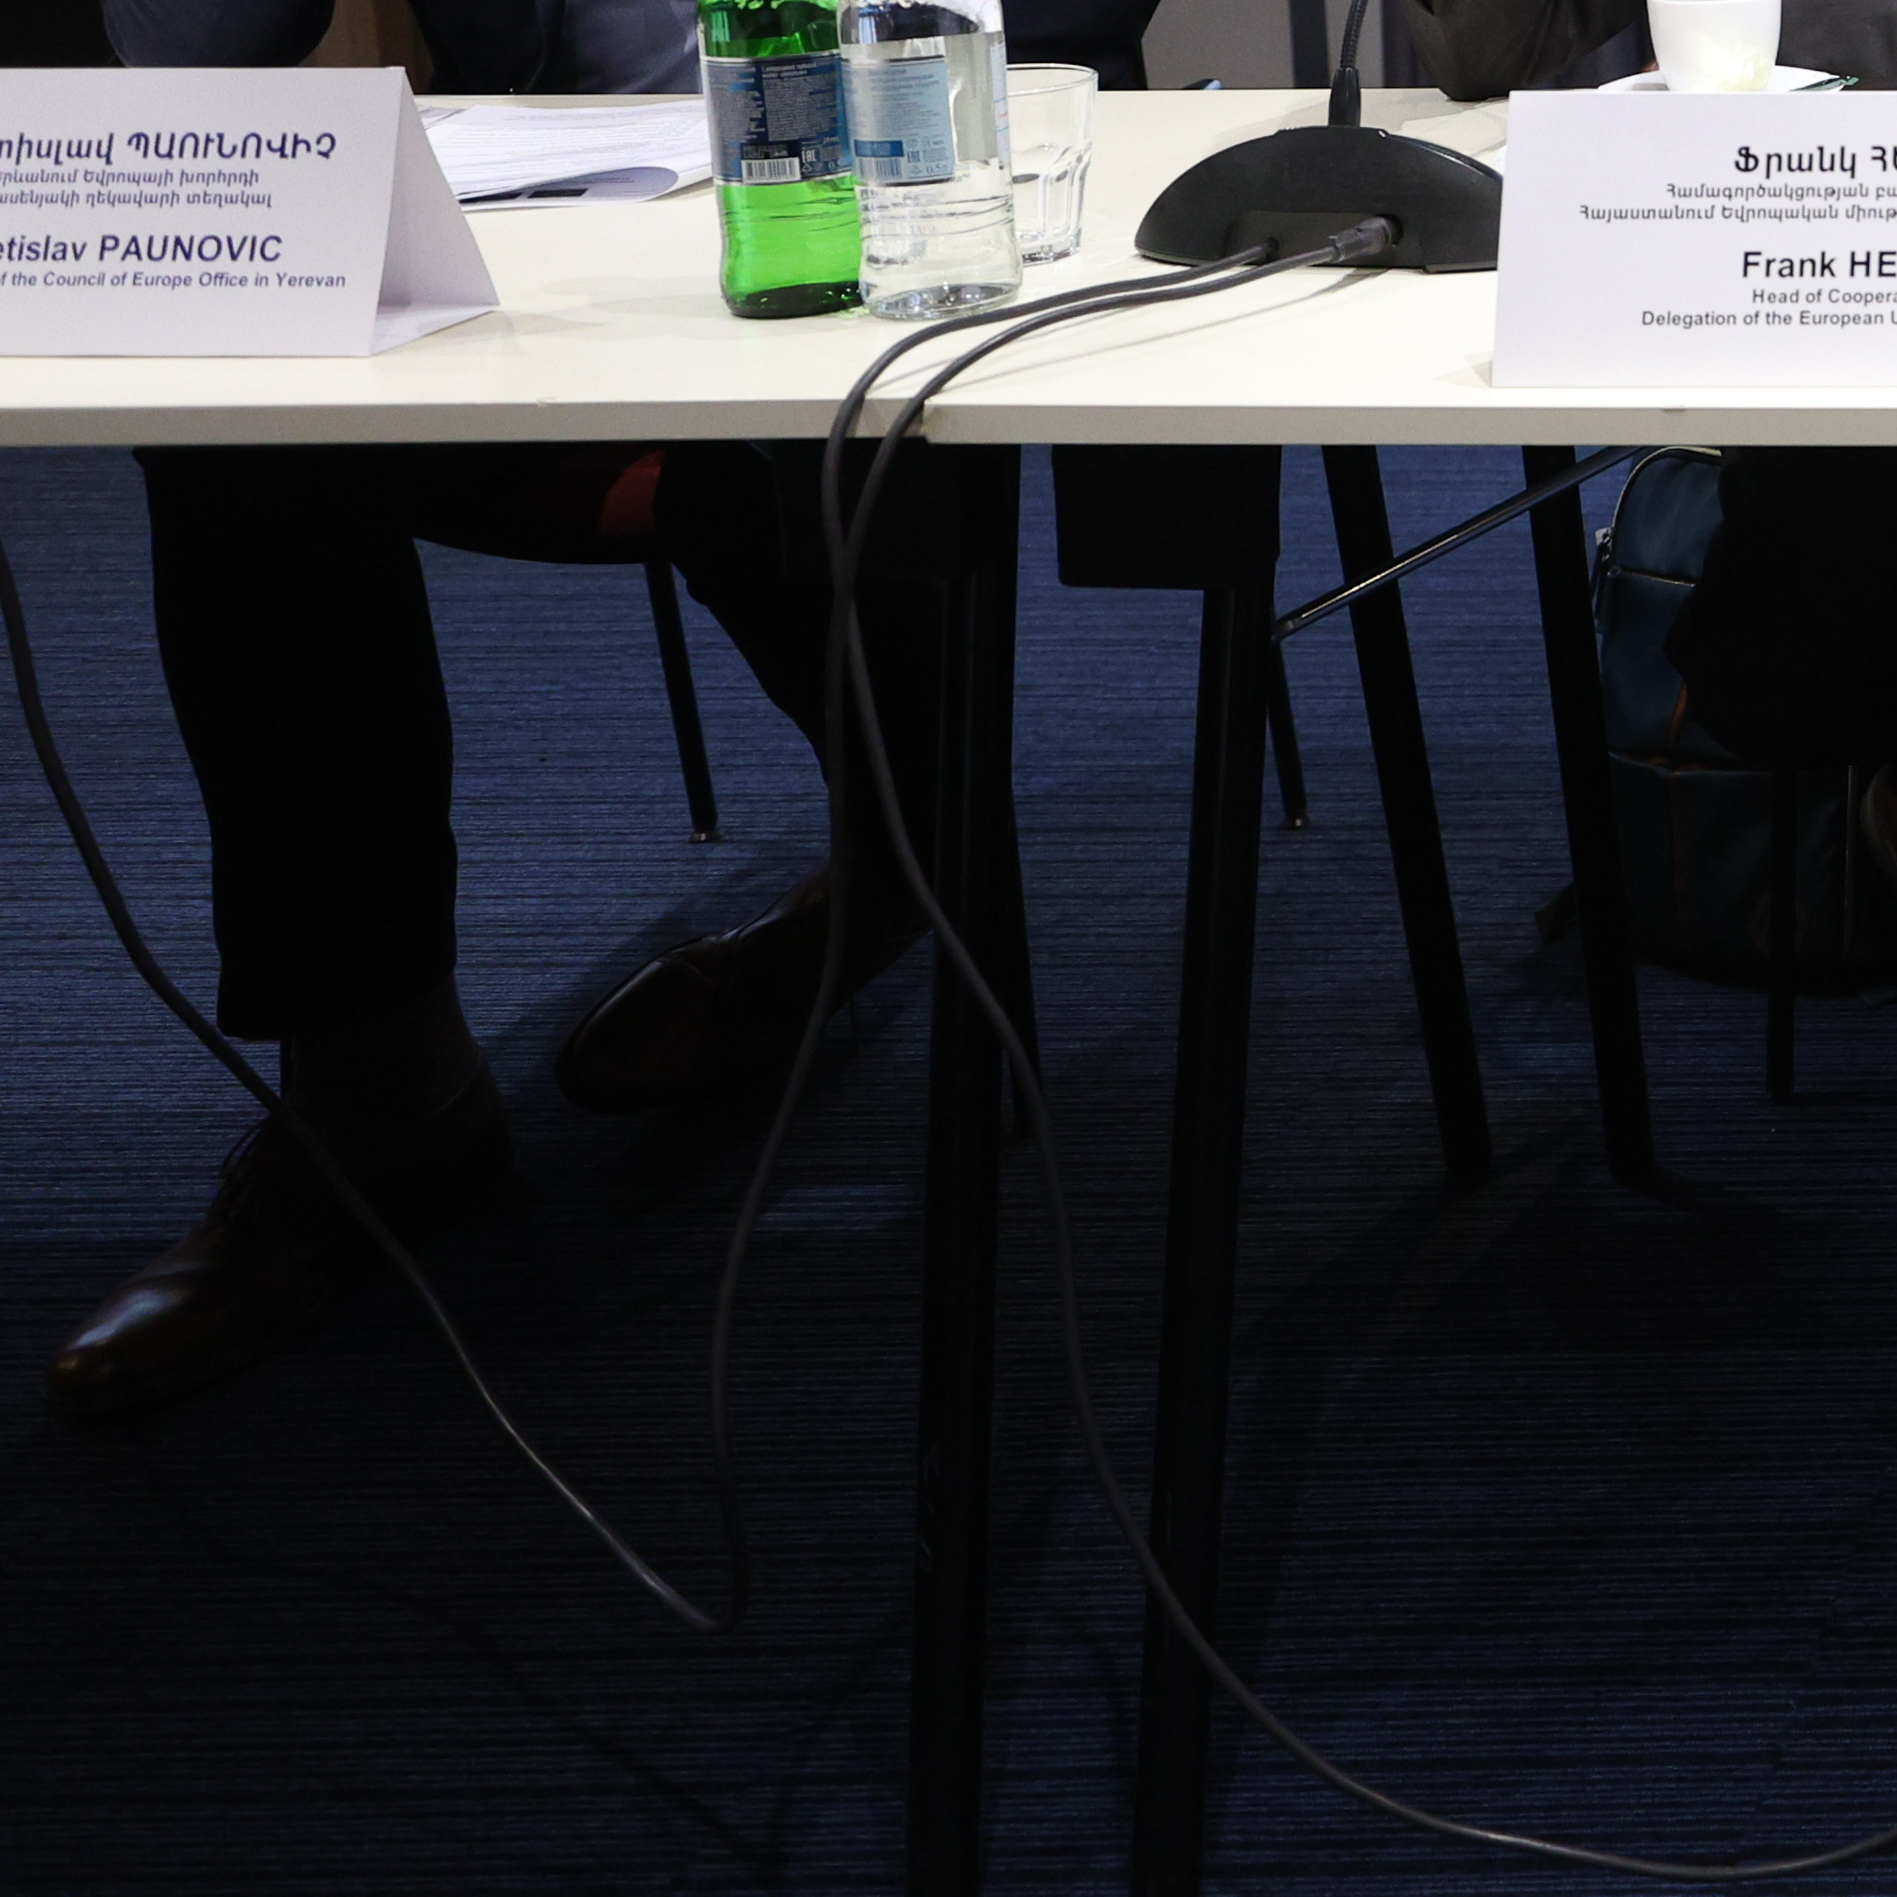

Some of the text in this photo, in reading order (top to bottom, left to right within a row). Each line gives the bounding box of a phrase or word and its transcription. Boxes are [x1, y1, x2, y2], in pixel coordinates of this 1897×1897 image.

[127, 132, 337, 160] ՊԱՈՒՆՈՎԻՉ
[1734, 146, 1856, 179] Ֆրանկ
[83, 168, 173, 187] Եվրոպայի
[179, 168, 259, 187] խորհրդի
[85, 191, 180, 209] ղեկավարի
[186, 191, 273, 209] տեղակալ
[1666, 183, 1869, 201] Համագործակցության
[1579, 204, 1715, 223] Հայաստանում
[1721, 204, 1839, 223] Եվրոպական
[99, 234, 284, 263] PAUNOVIC
[1742, 251, 1837, 278] Frank
[11, 271, 37, 287] the
[43, 270, 105, 287] Council
[110, 270, 127, 287] of
[132, 271, 193, 290] Europe
[199, 271, 249, 287] Office
[254, 271, 270, 287] in
[275, 272, 346, 288] Yerevan
[1752, 288, 1800, 304] Head
[1805, 288, 1823, 304] of
[1641, 310, 1737, 329] Delegation
[1743, 310, 1760, 326] of
[1765, 310, 1793, 326] the
[1799, 310, 1885, 329] European
